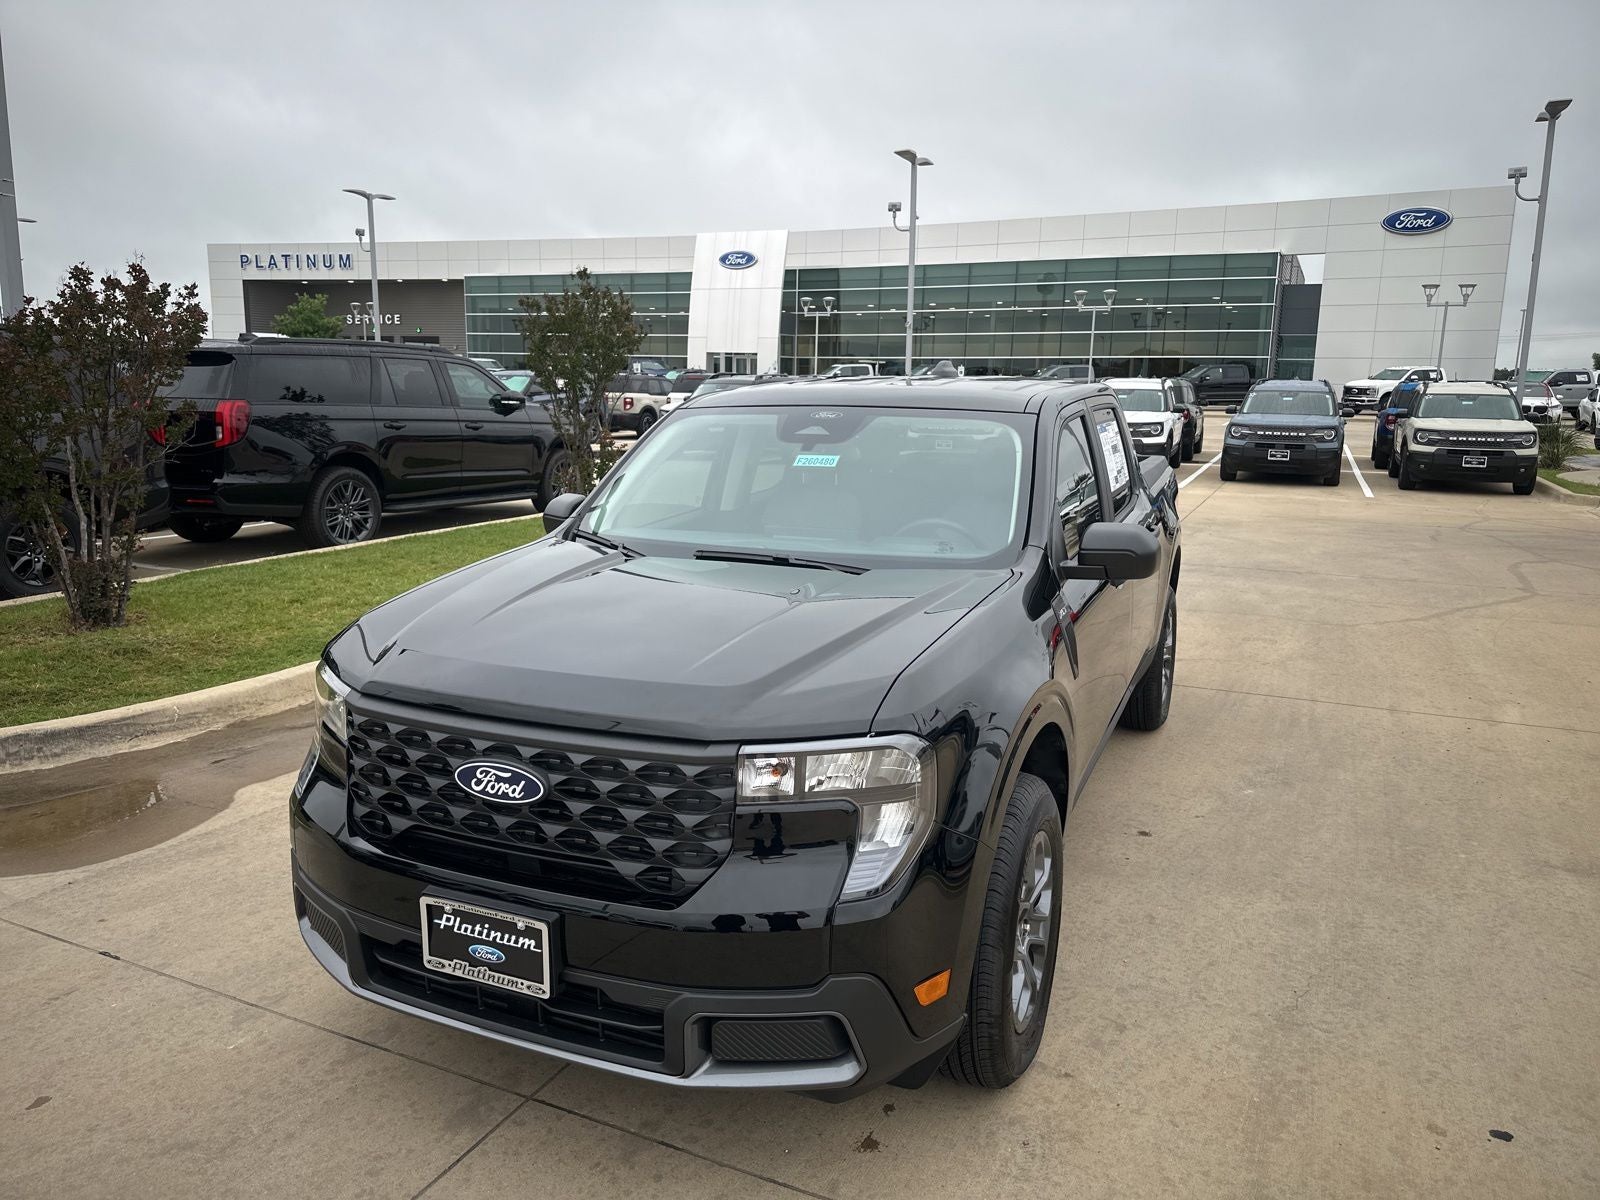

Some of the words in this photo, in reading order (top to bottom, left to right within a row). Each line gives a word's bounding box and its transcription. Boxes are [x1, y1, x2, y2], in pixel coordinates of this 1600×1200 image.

[1395, 212, 1437, 229] Ford
[240, 253, 353, 270] PLATINUM
[725, 253, 748, 265] Ford
[796, 457, 835, 466] F260480
[471, 767, 526, 799] Ford
[433, 913, 542, 953] Platinum
[475, 946, 499, 961] Ford
[451, 959, 525, 991] Platinum
